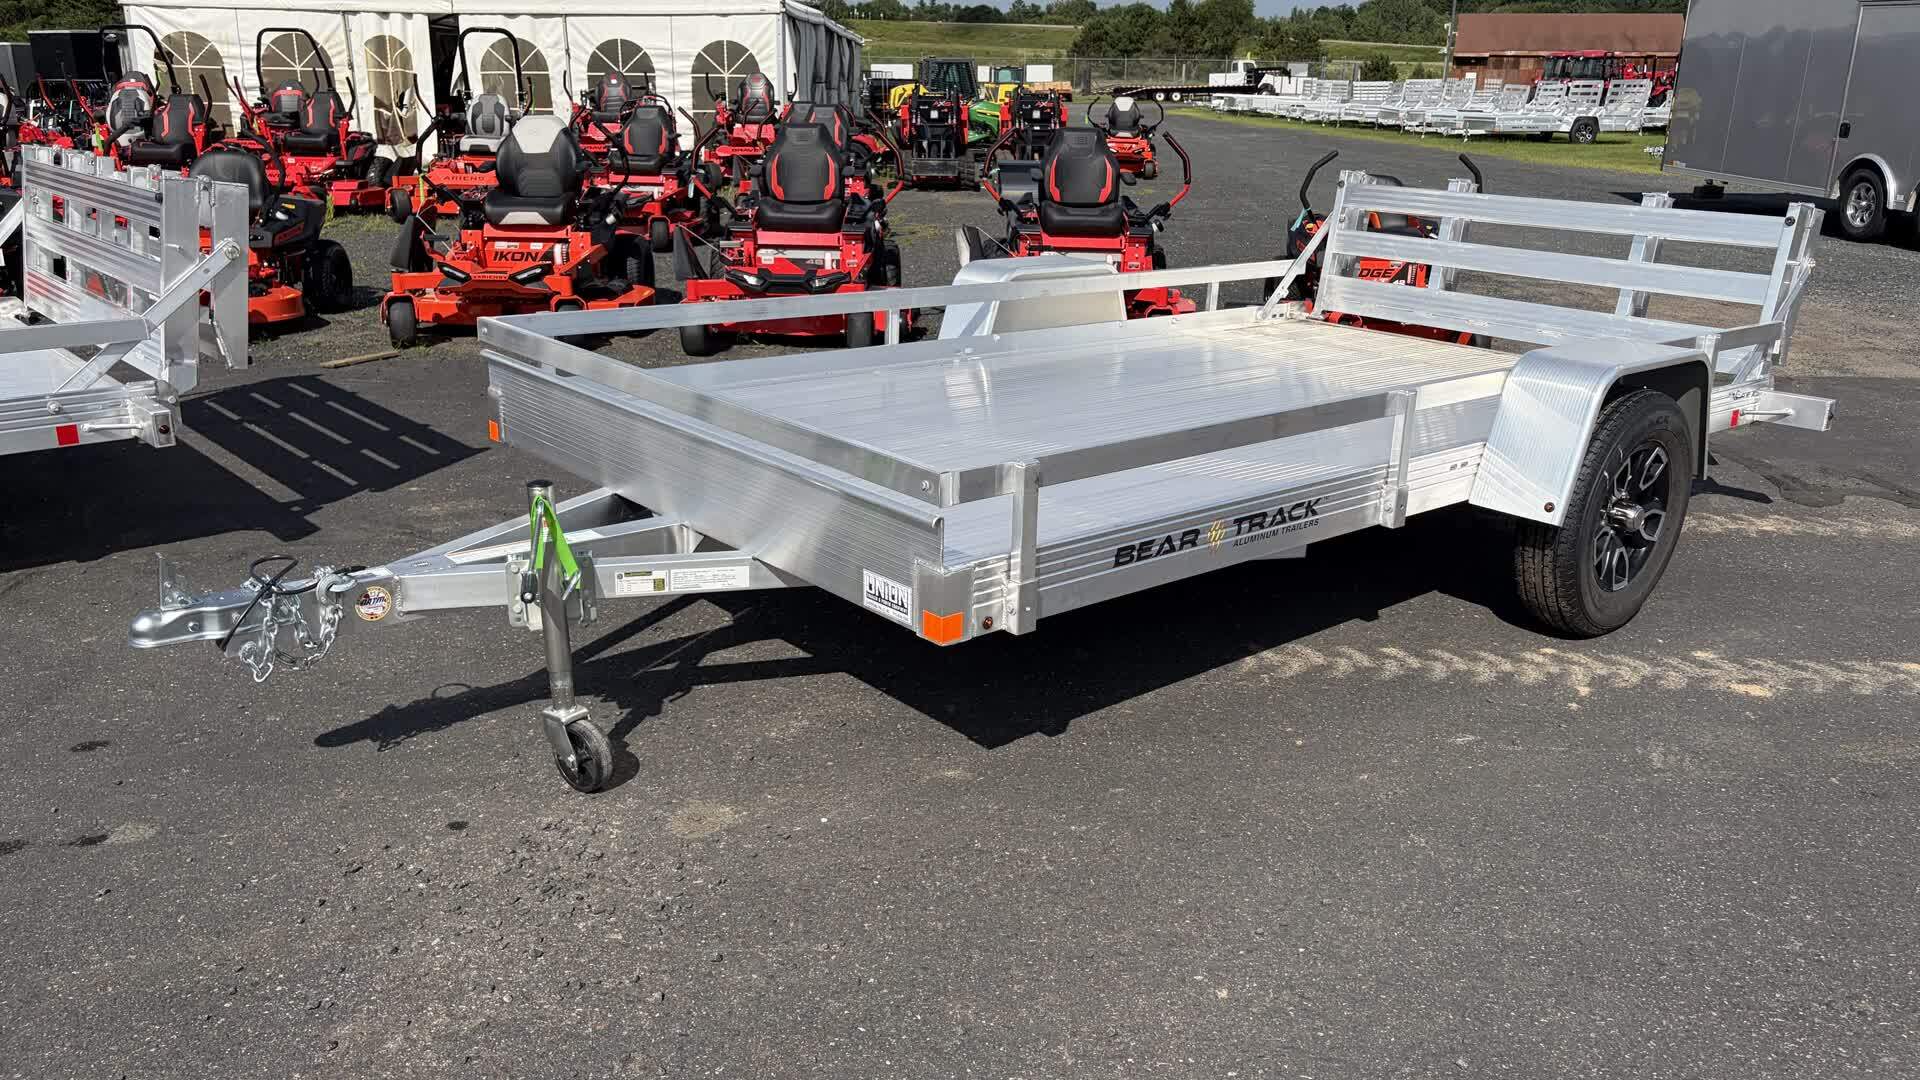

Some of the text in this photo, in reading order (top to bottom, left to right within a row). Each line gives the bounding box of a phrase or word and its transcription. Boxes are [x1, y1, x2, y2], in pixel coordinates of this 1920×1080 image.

[493, 251, 539, 262] IKON
[1358, 268, 1394, 278] DGE
[1113, 498, 1321, 568] BEAR TRACK
[1233, 518, 1319, 547] ALUMINUM TRAILERS
